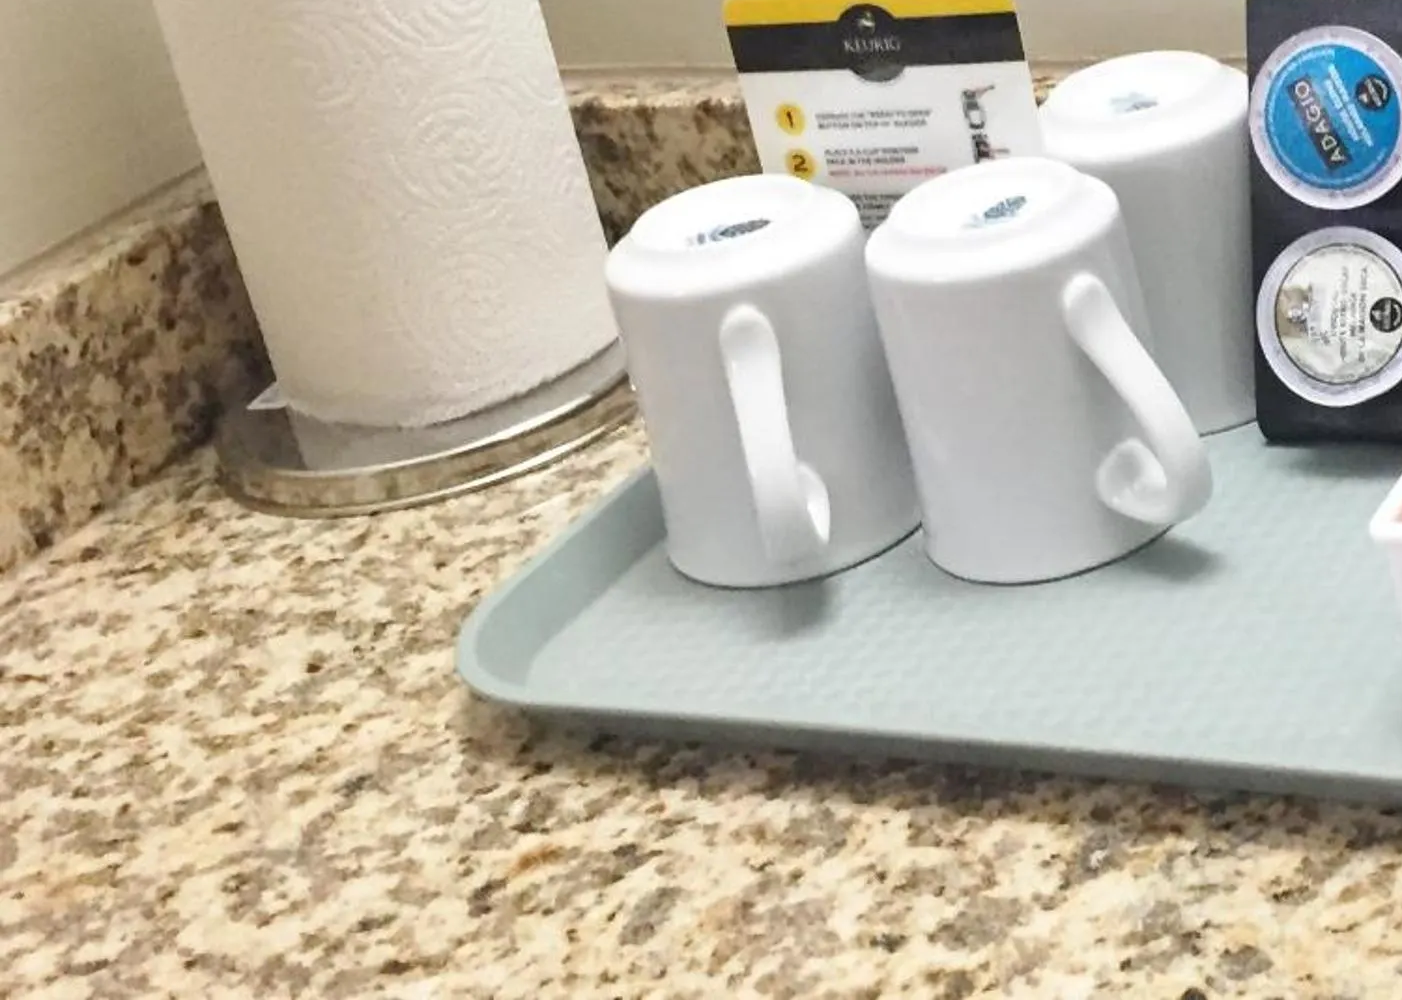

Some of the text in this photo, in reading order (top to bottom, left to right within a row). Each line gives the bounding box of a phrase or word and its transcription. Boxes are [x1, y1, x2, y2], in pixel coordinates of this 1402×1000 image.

[786, 109, 796, 128] 1
[1294, 80, 1347, 164] ADAGIO
[792, 154, 809, 173] 2
